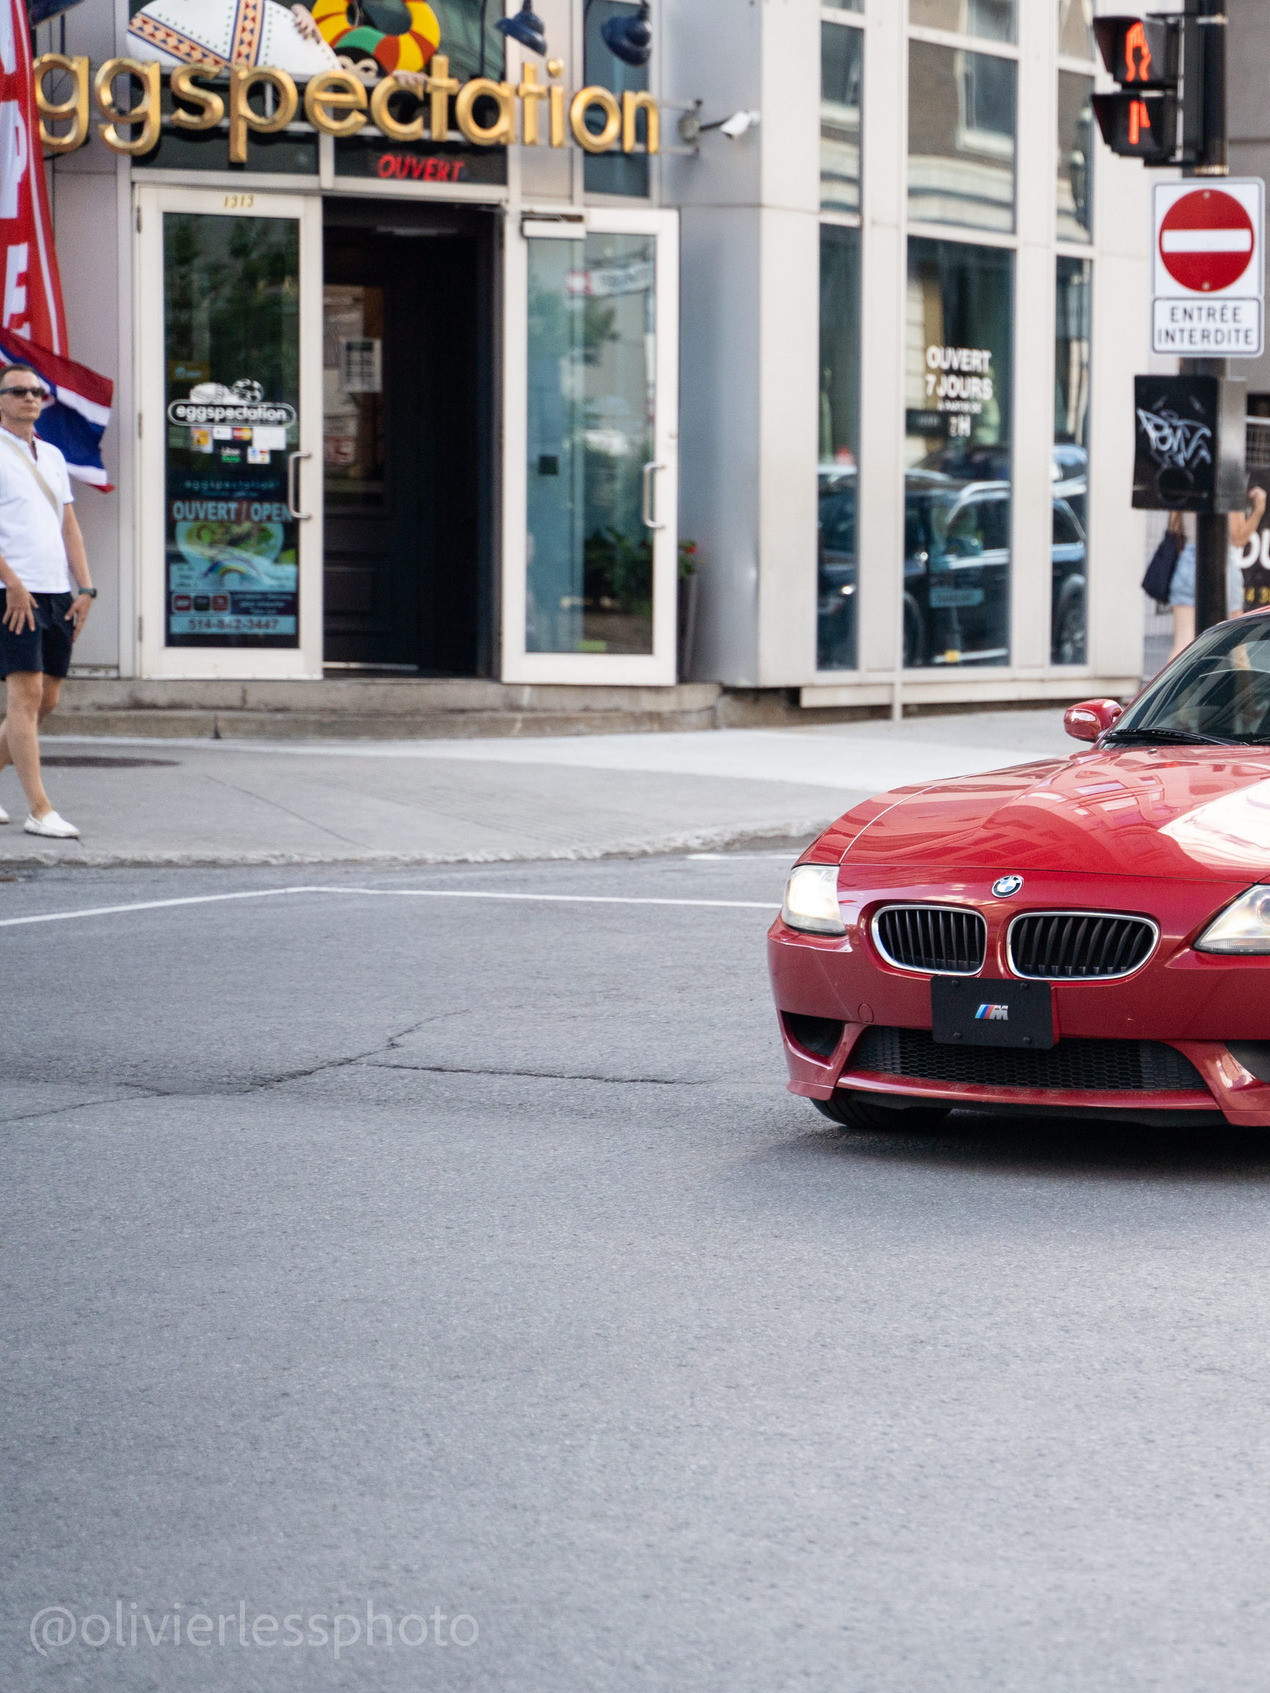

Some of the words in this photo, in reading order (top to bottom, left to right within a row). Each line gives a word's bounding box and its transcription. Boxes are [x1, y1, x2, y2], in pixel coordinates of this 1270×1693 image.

[34, 54, 661, 163] ggspectation
[377, 152, 465, 183] OUVERT
[223, 193, 255, 209] 1313
[1170, 303, 1243, 323] ENTRÉE
[1157, 328, 1254, 345] INTERDITE
[926, 345, 992, 373] OUVERT
[924, 373, 937, 397] 7
[936, 374, 994, 400] JOURS
[175, 405, 288, 422] eggspectation
[173, 499, 238, 521] OUVERT
[250, 502, 294, 523] OPEN
